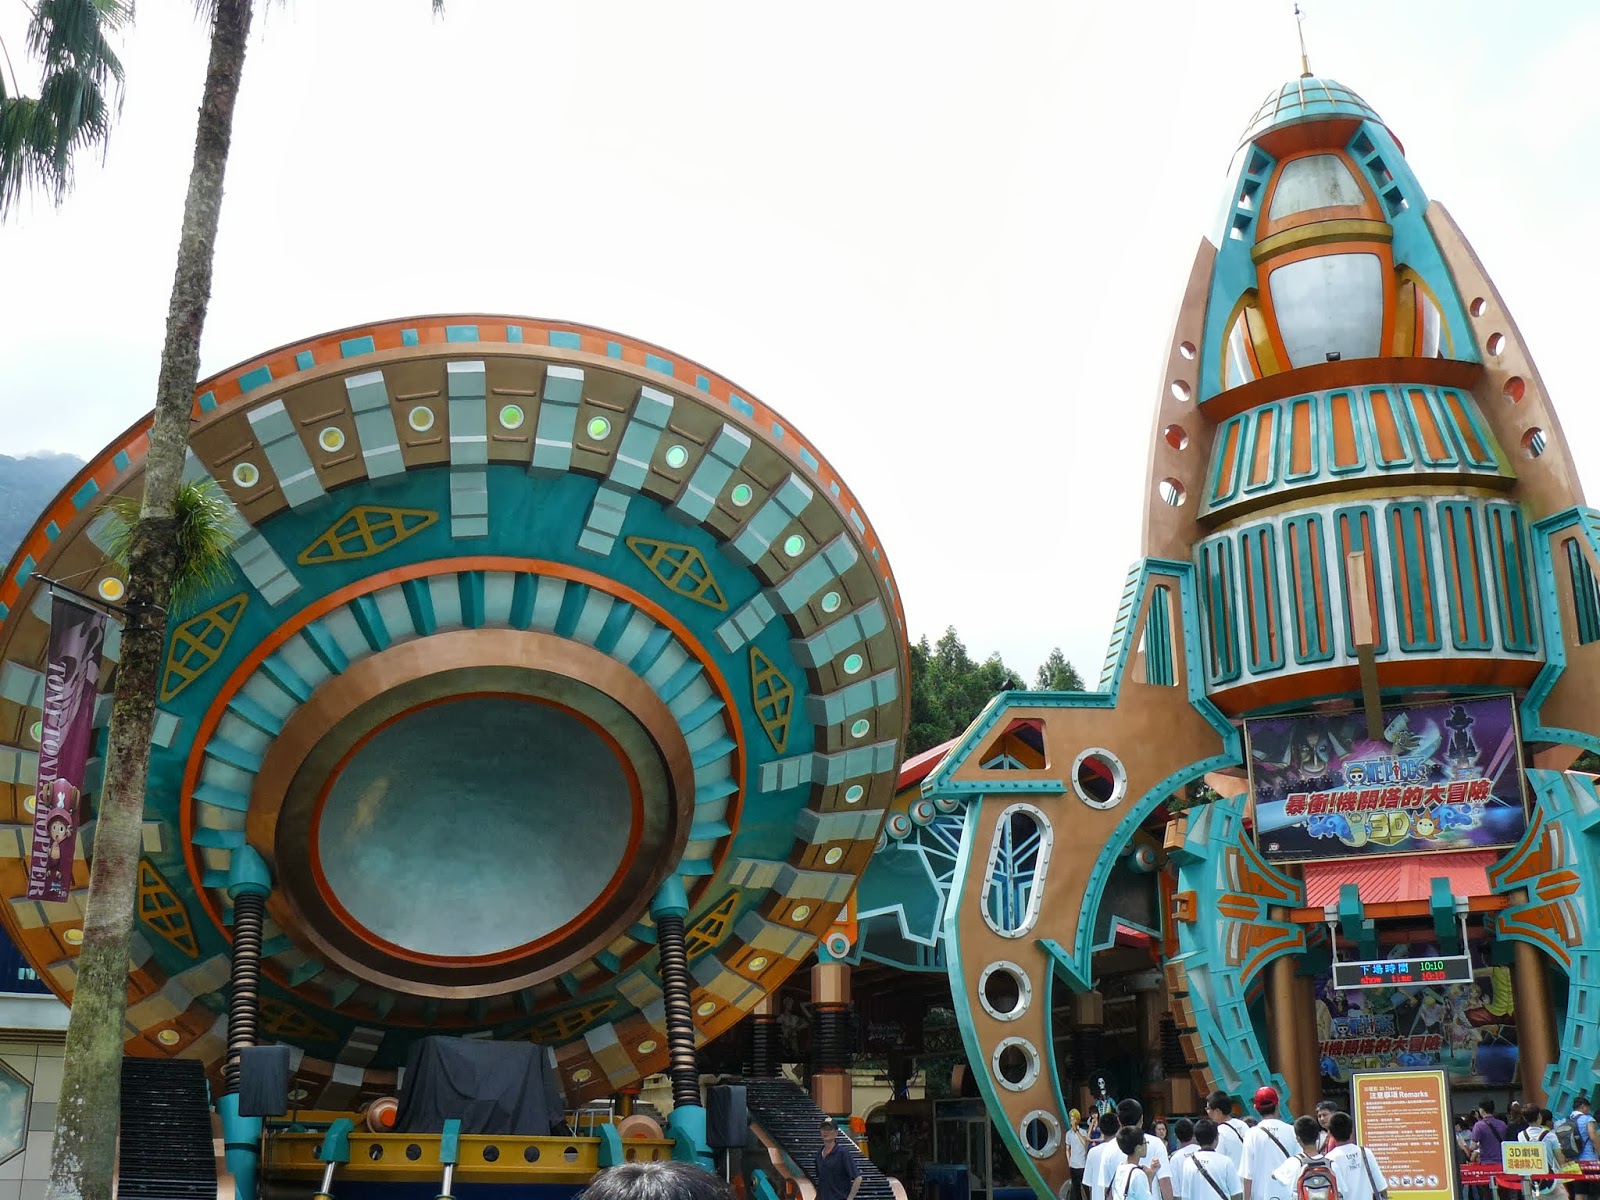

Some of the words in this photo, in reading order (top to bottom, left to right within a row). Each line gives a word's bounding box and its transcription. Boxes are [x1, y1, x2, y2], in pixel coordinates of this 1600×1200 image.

[45, 661, 66, 723] TONY
[1369, 812, 1410, 843] 3D
[1420, 961, 1443, 971] 10:10
[1421, 971, 1445, 981] 10:10
[1399, 1090, 1428, 1098] Remarks
